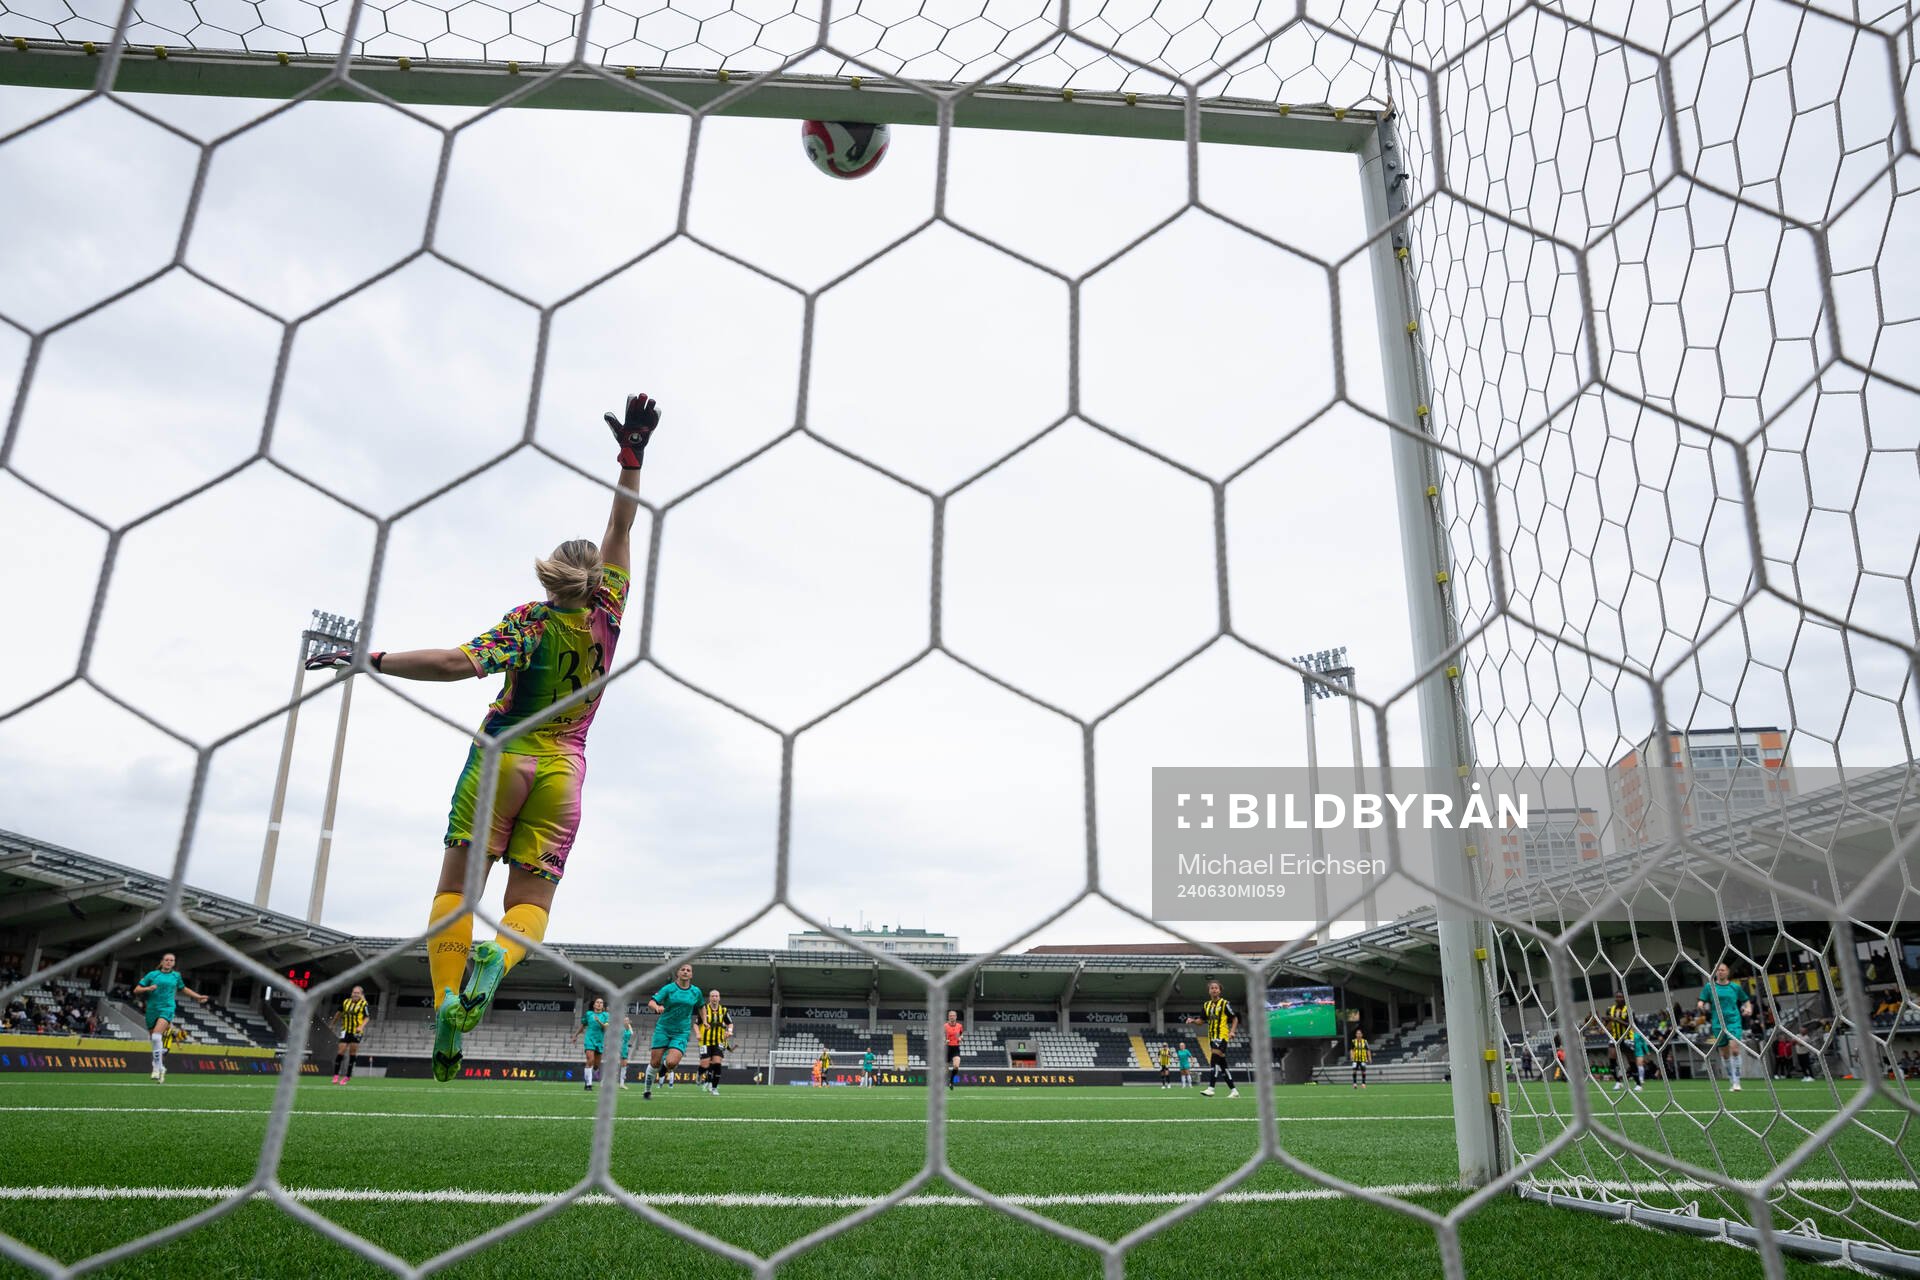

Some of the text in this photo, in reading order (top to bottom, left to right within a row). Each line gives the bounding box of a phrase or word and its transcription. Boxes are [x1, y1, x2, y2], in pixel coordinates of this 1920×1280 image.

[551, 643, 605, 704] 33
[525, 1000, 561, 1011] bravida
[814, 1008, 849, 1019] bravida
[1001, 1011, 1035, 1022] bravida
[1095, 1012, 1129, 1023] bravida
[69, 1055, 128, 1069] PARTNERS
[465, 1068, 492, 1078] HAR
[1006, 1075, 1076, 1084] PARTNERS
